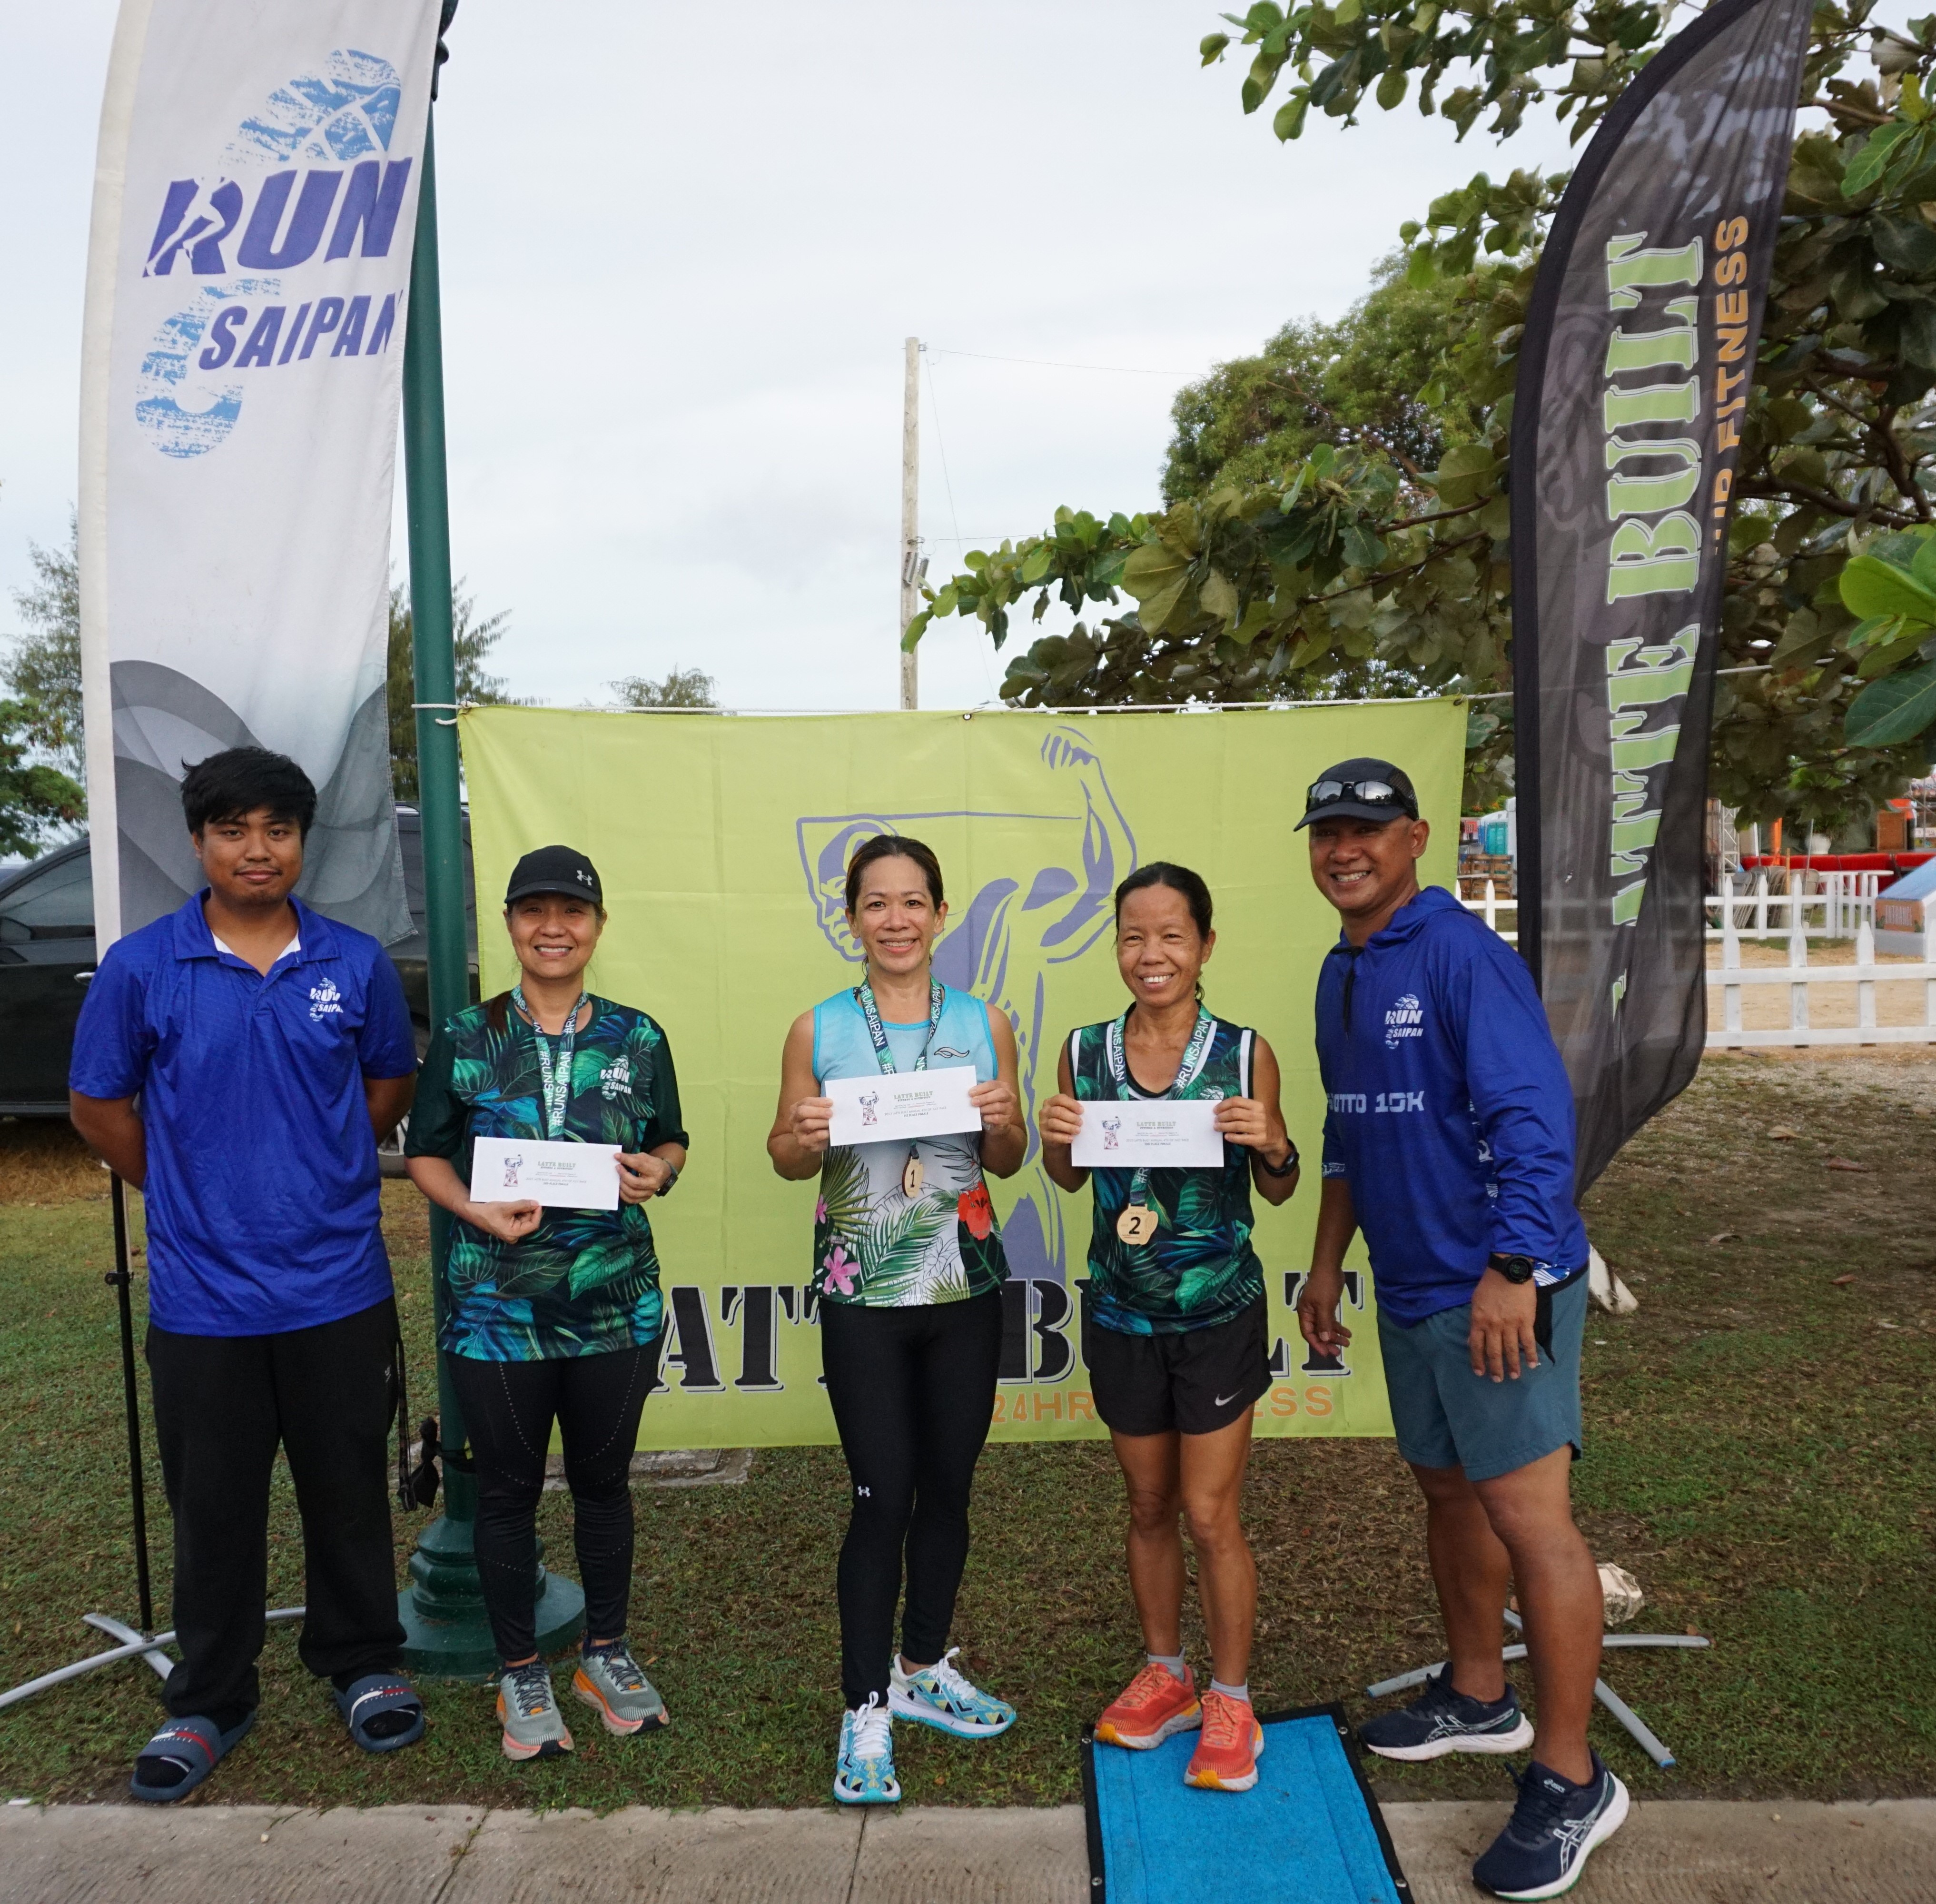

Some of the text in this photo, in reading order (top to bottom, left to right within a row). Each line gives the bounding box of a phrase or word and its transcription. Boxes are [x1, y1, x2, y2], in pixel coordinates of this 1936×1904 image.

[142, 157, 413, 278] RUN
[1715, 215, 1749, 454] FITNESS
[1604, 231, 1703, 605] BUILT
[860, 984, 885, 1047] #RUNSAIPAN
[1385, 1010, 1423, 1025] RUN
[1393, 1027, 1423, 1038] SAIPAN
[1174, 1017, 1211, 1089] #RUNSAIPAN
[552, 1051, 572, 1127] #RUNSAIPAN
[600, 1067, 630, 1083] RUN
[1375, 1091, 1425, 1113] 10K
[910, 1169, 915, 1188] 1
[1128, 1216, 1141, 1235] 2
